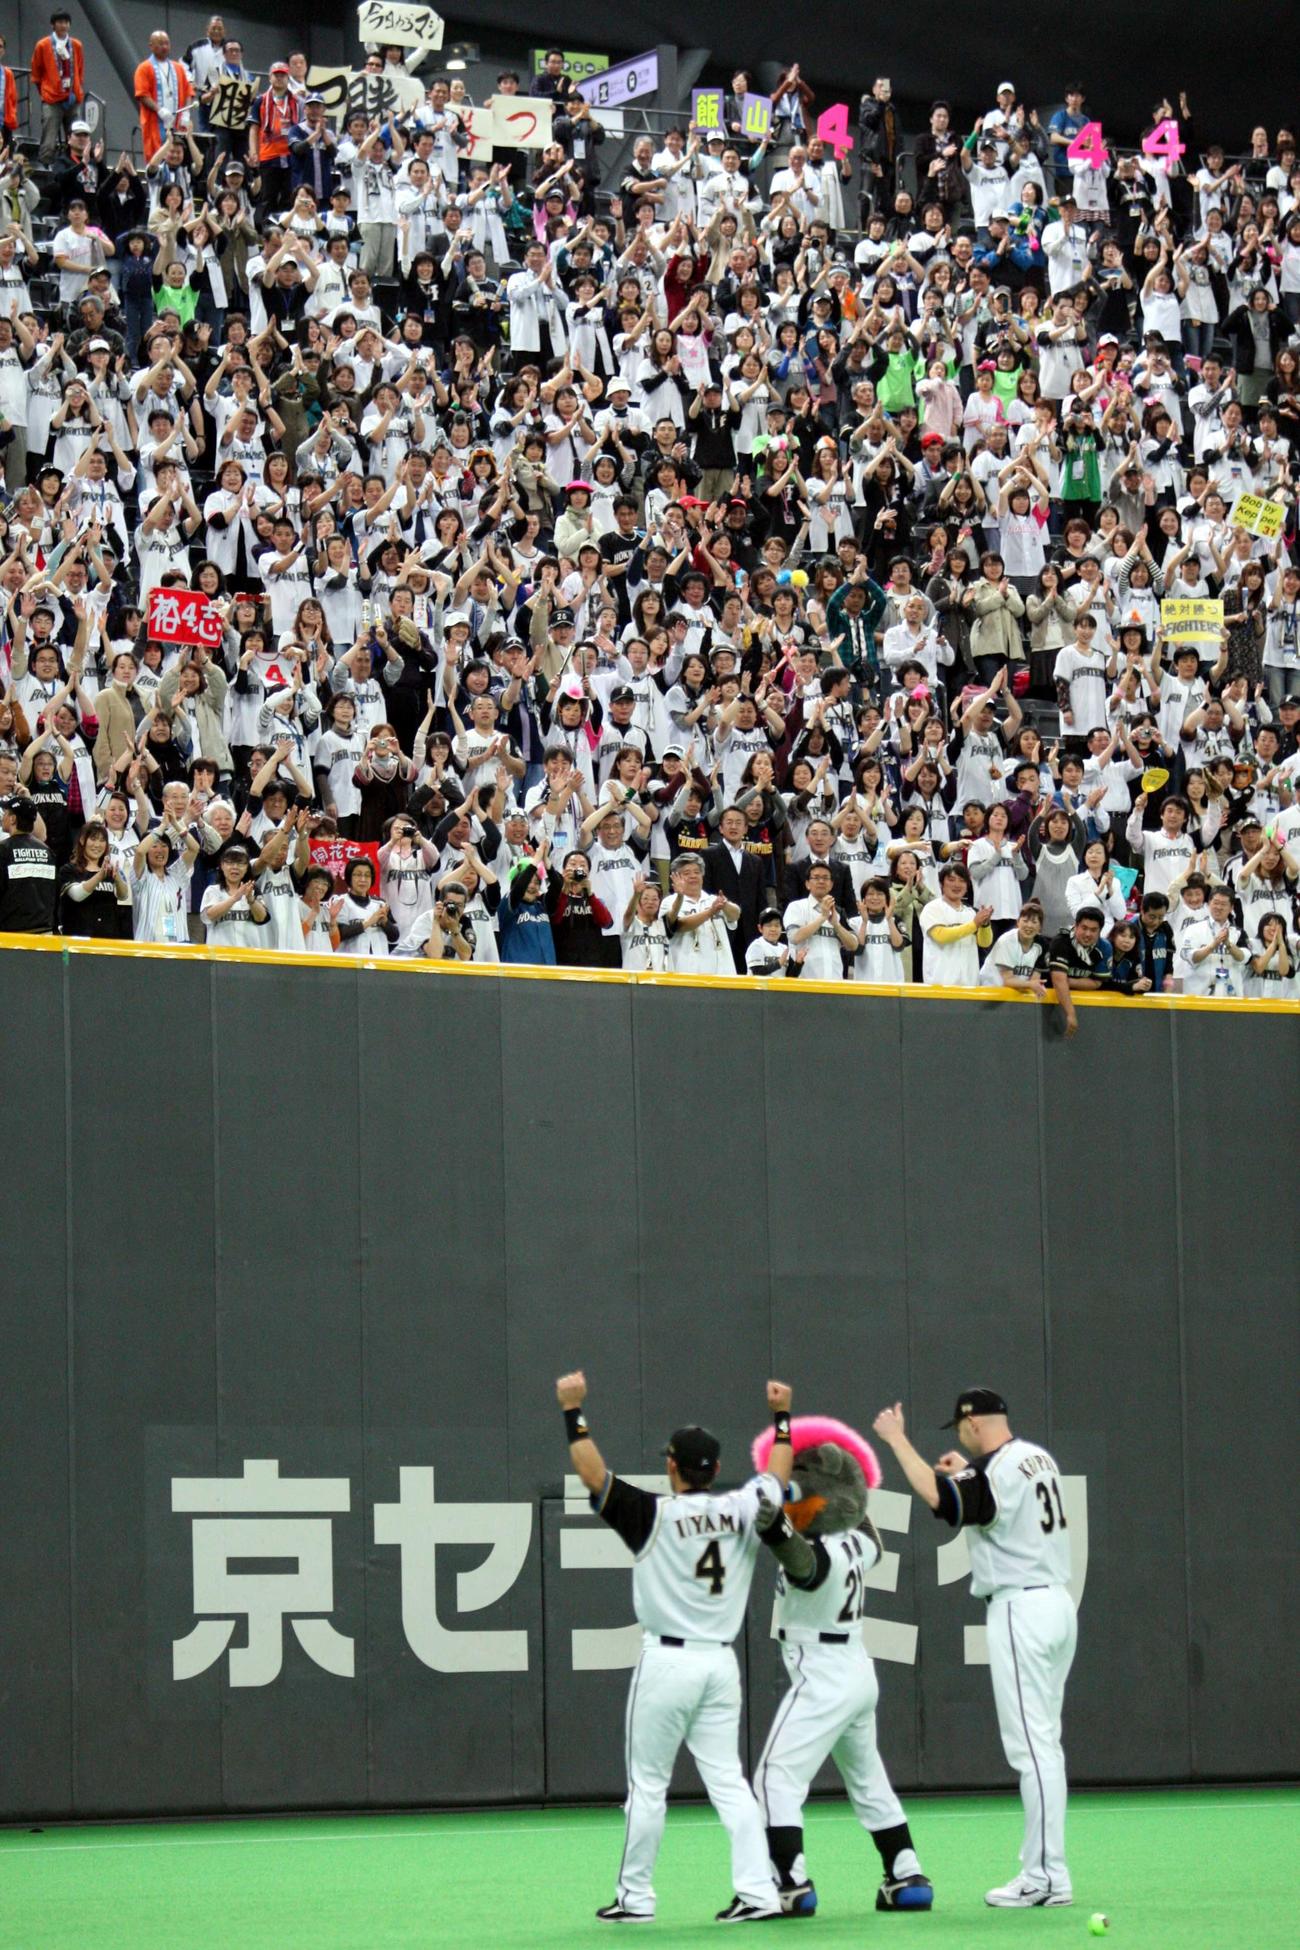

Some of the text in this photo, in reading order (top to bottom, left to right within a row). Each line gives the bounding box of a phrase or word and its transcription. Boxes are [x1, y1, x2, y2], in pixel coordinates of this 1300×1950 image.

[506, 111, 537, 141] つ
[696, 94, 720, 129] 飯
[745, 100, 768, 134] 山
[817, 104, 853, 160] 4
[1067, 121, 1108, 168] 4
[1142, 121, 1186, 168] 4
[1164, 620, 1221, 635] FIGHTERS
[13, 849, 48, 858] FIGHTERS
[1036, 1477, 1067, 1534] 31
[695, 1539, 726, 1594] 4
